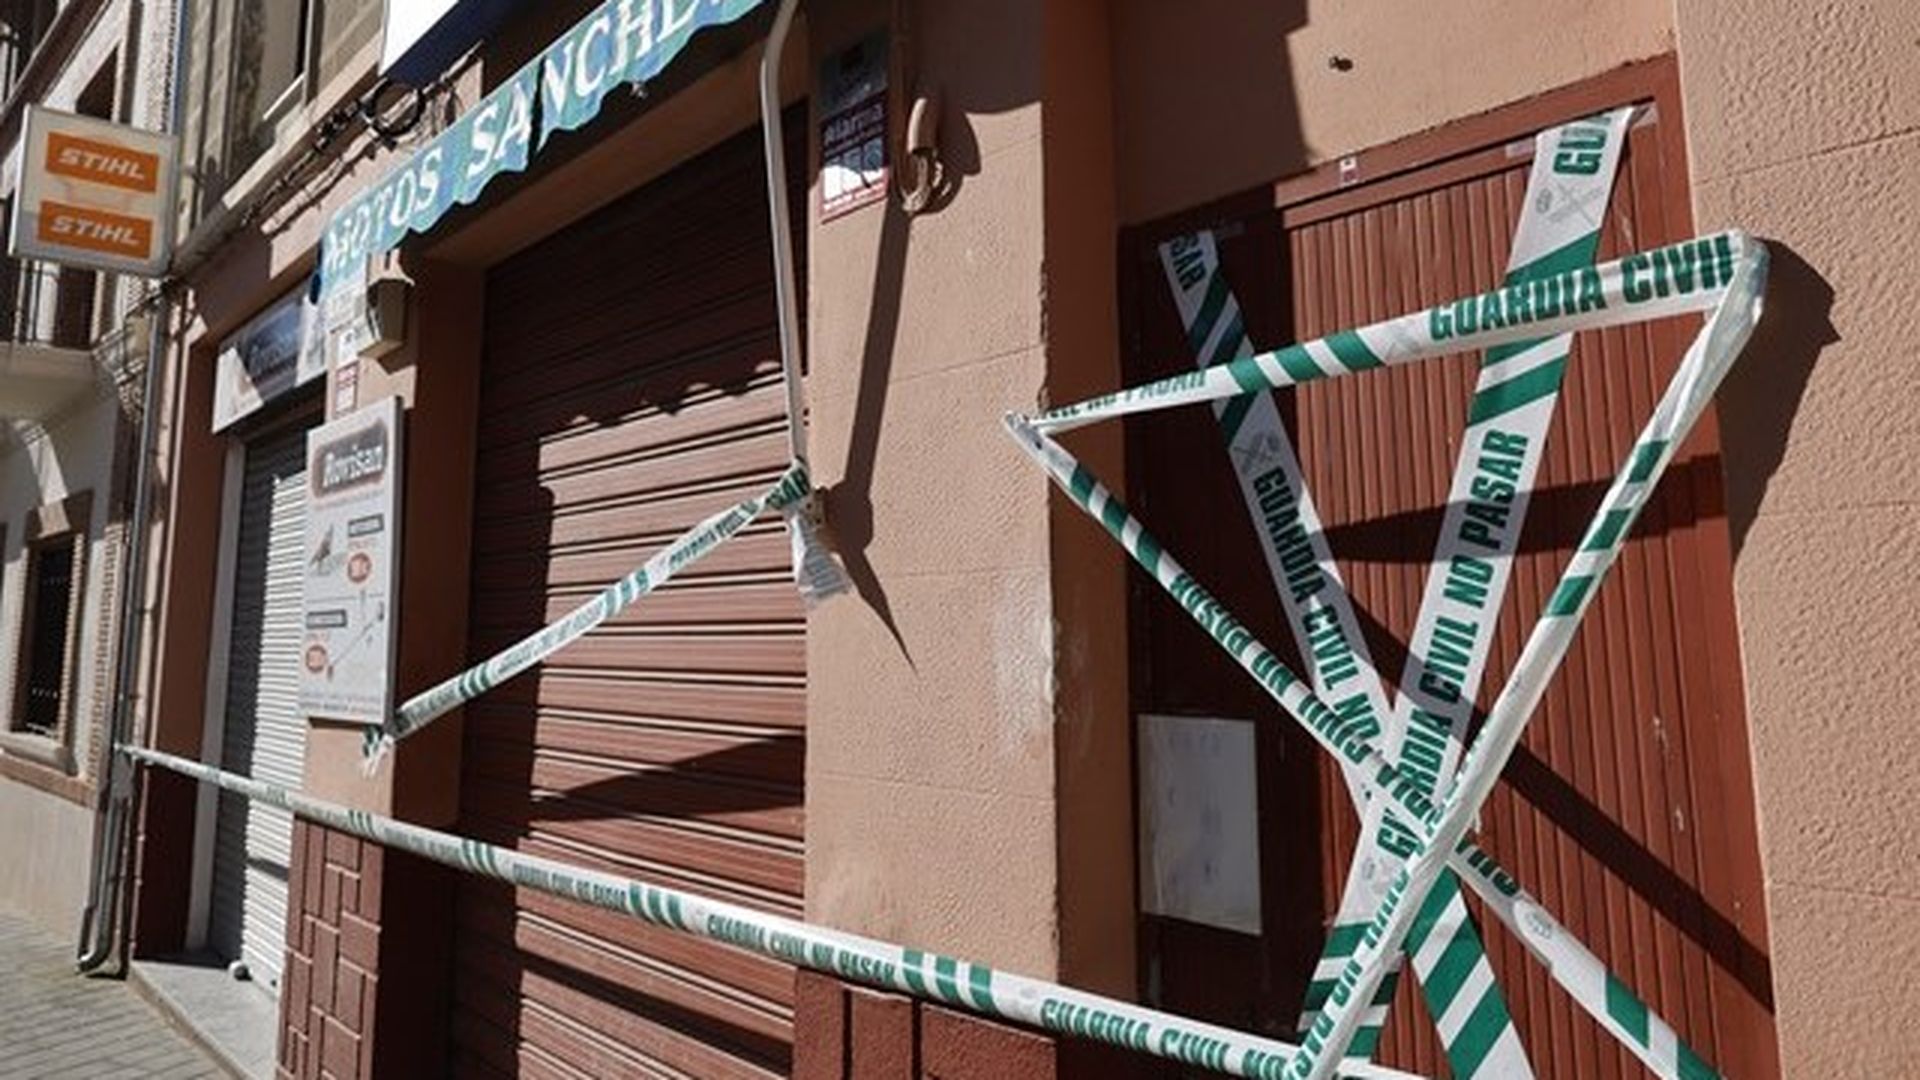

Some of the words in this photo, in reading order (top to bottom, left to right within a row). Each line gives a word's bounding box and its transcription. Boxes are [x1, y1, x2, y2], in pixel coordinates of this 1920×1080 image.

[466, 0, 722, 180] SANCHE
[58, 147, 145, 180] STIHL
[50, 215, 140, 245] STIHL
[1429, 265, 1608, 341] GUARDIA
[1460, 429, 1529, 550] PASAR
[1252, 467, 1327, 604] GUARDIA
[1303, 603, 1359, 692] CIVIL
[1443, 553, 1495, 610] NO
[1418, 616, 1480, 703] CIVIL
[837, 949, 896, 985] PASAR
[1041, 998, 1152, 1046] GUARDIA
[1158, 1028, 1230, 1071] CIVIL
